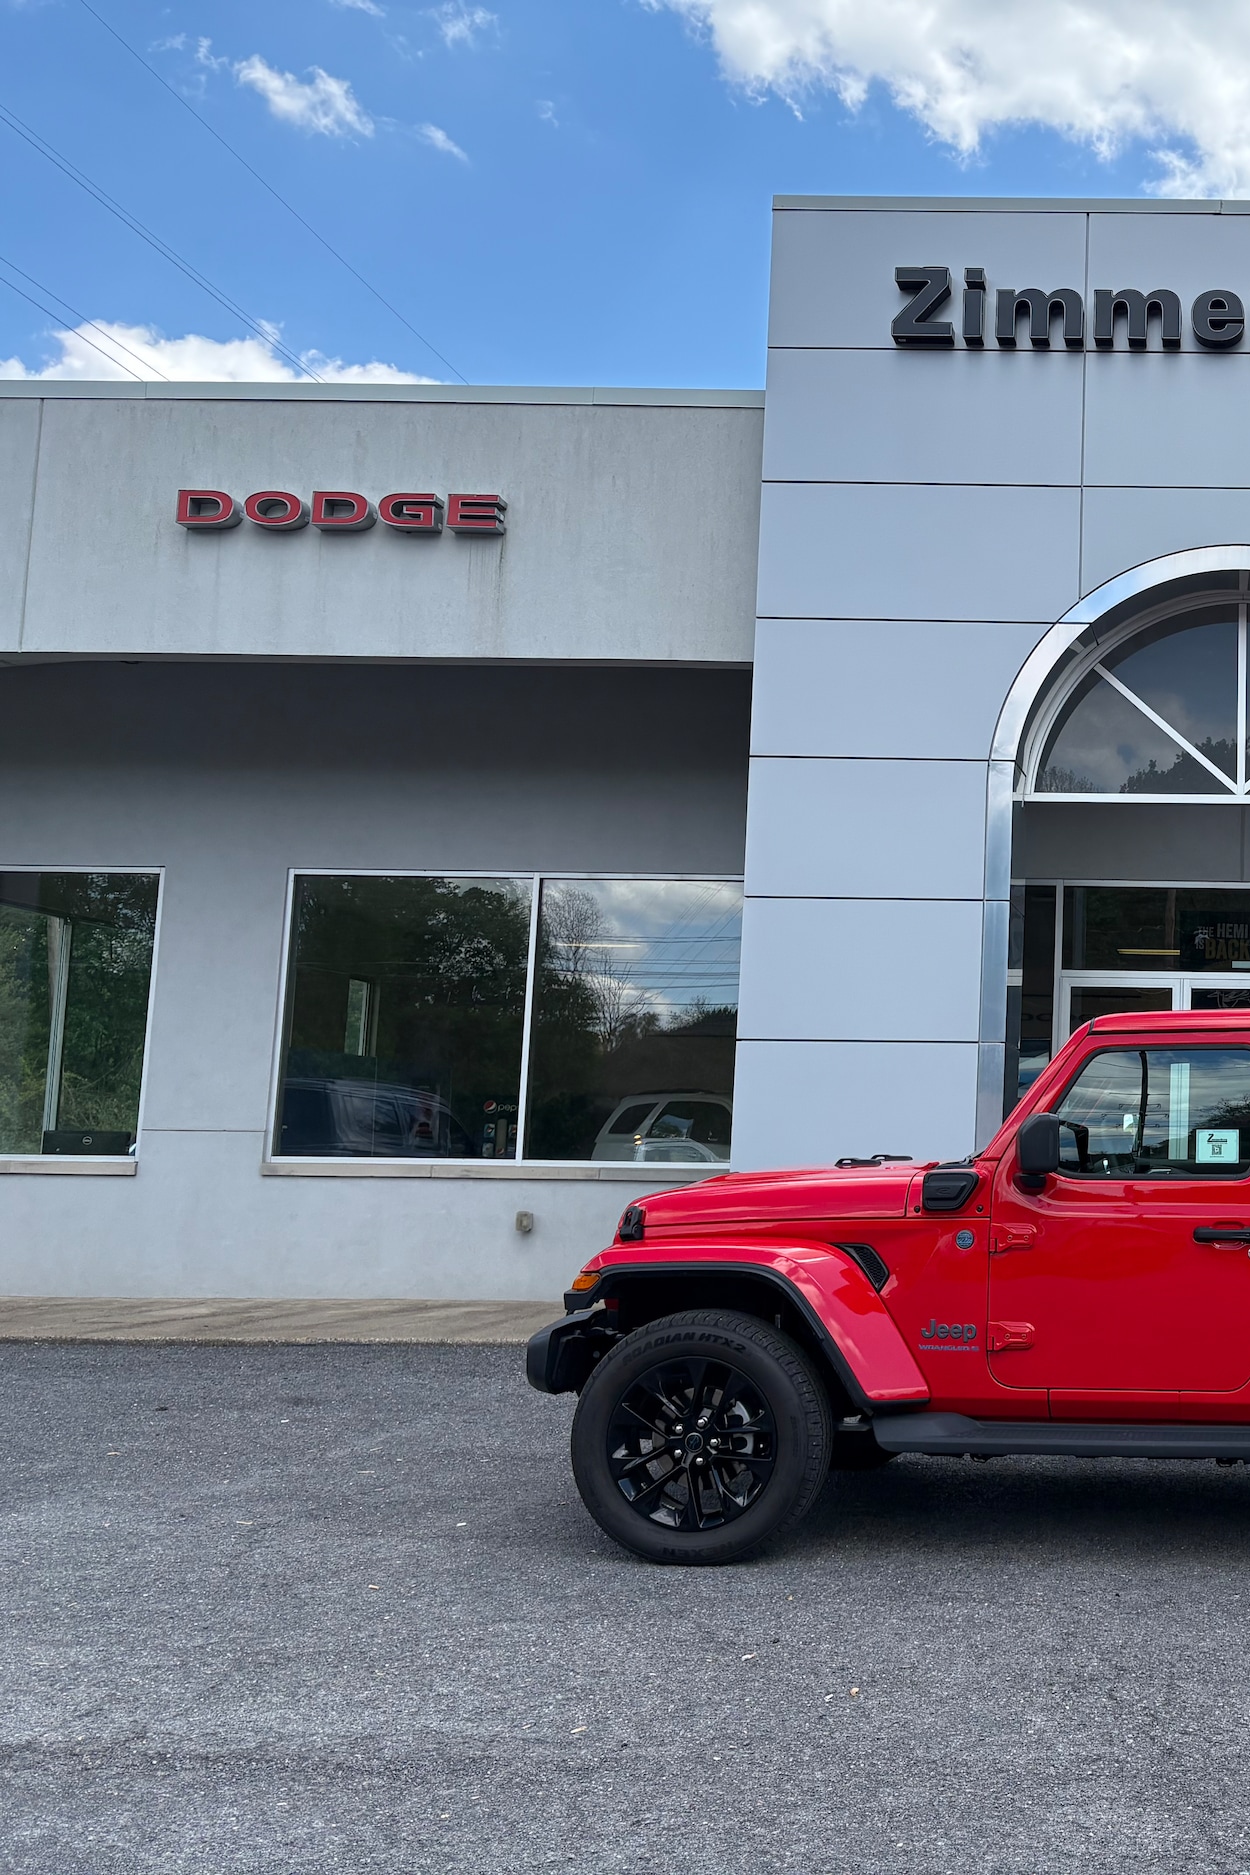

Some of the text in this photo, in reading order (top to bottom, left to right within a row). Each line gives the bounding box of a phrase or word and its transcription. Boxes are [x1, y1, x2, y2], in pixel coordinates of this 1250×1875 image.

[175, 489, 507, 533] DODGE
[1216, 922, 1249, 938] HEMI
[920, 1318, 977, 1343] Jeep
[621, 1331, 697, 1367] ROADIAN
